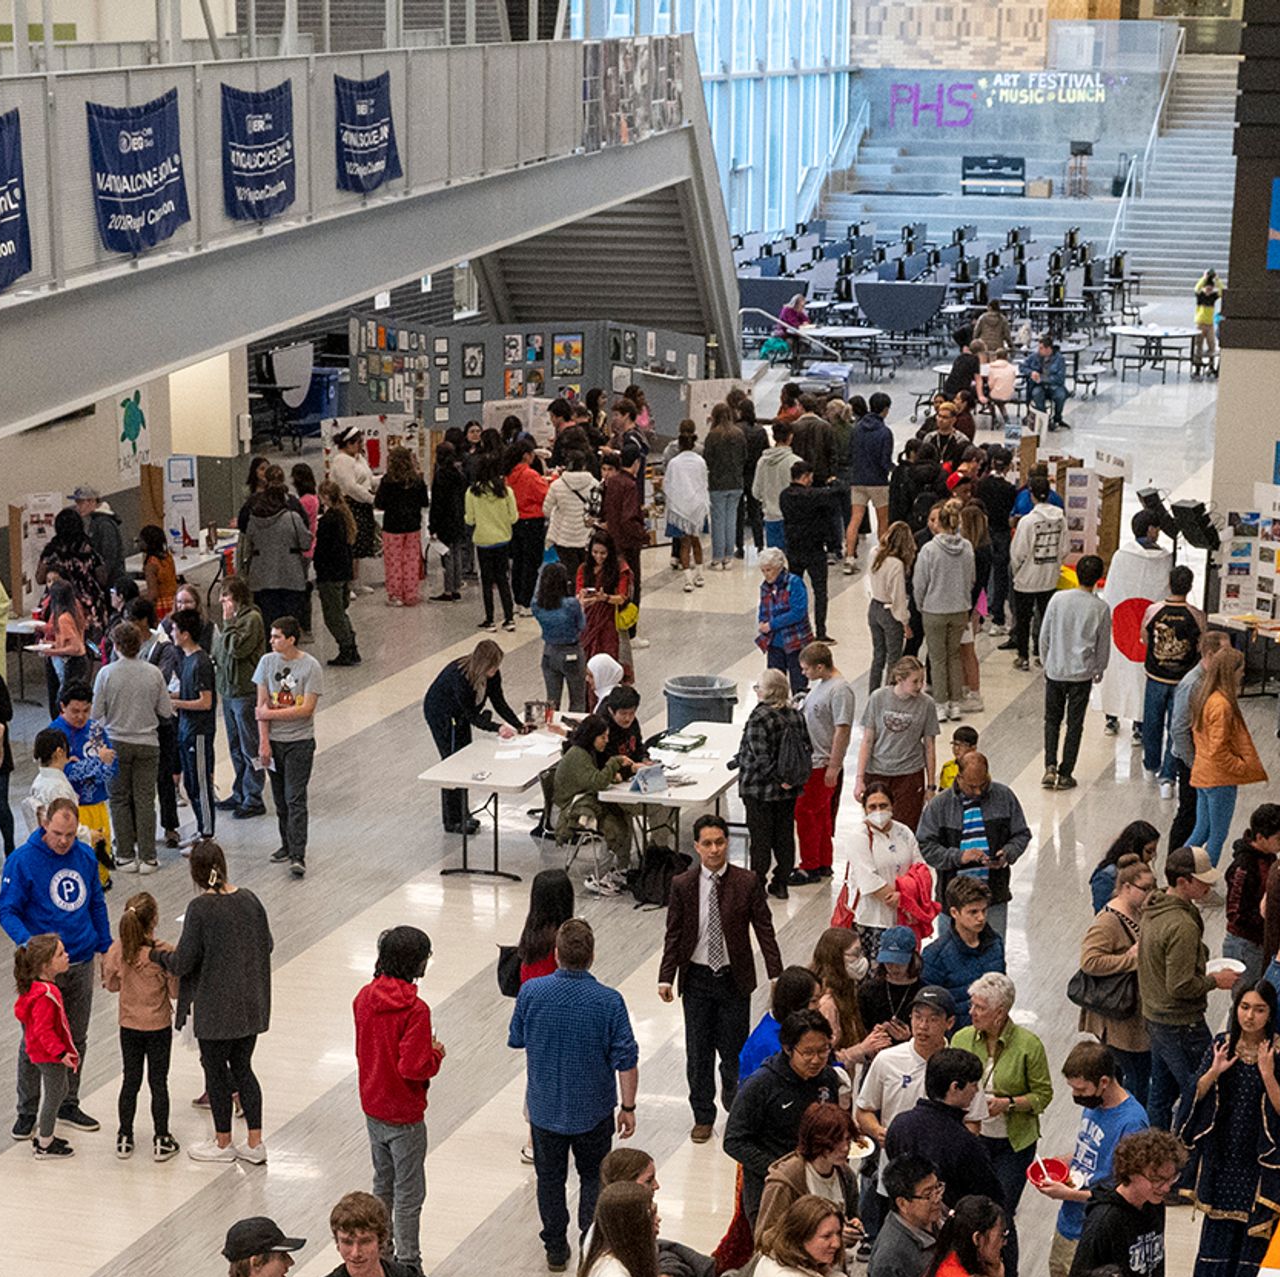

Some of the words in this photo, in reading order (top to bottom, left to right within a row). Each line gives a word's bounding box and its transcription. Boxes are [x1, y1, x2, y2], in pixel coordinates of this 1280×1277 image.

[993, 73, 1021, 87] ART
[1028, 72, 1104, 89] FESTIVAL
[998, 88, 1044, 103] MUSIC
[1057, 88, 1106, 103] LUNCH
[889, 83, 974, 128] PHS
[62, 880, 76, 901] P
[902, 1075, 912, 1088] P
